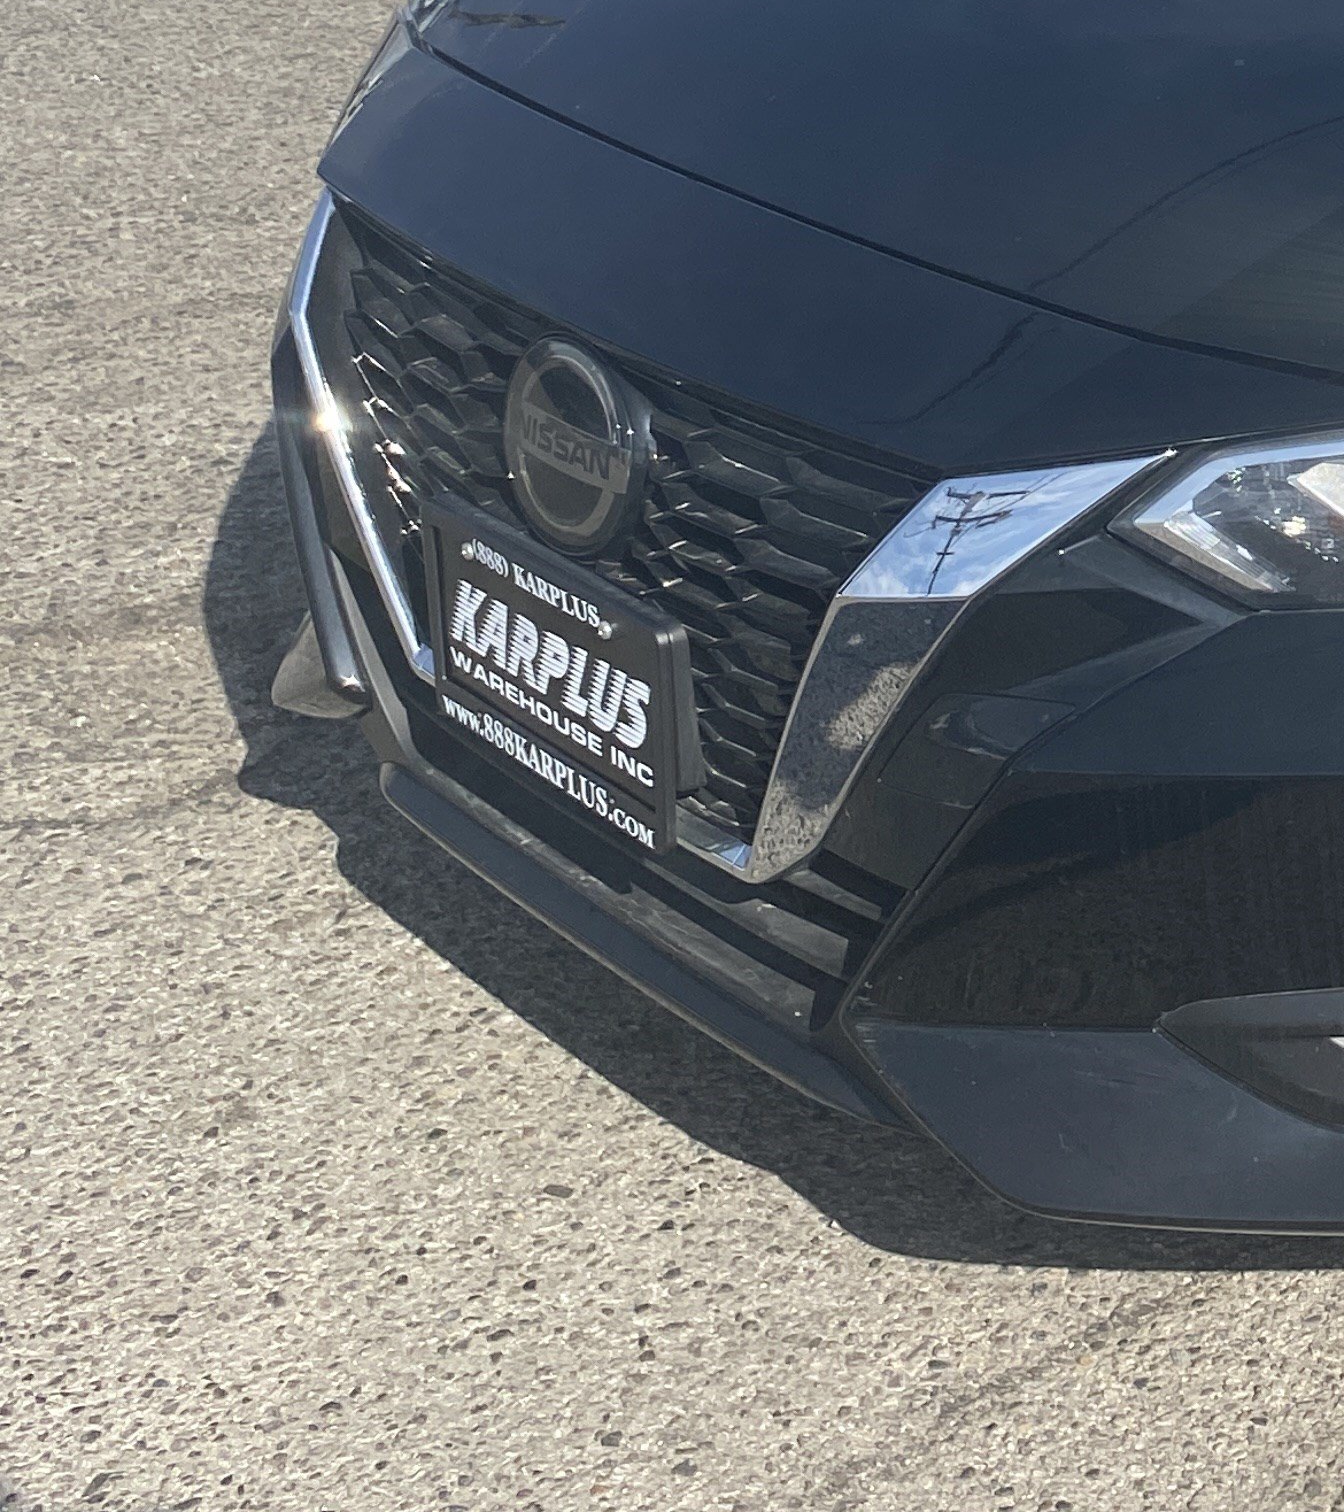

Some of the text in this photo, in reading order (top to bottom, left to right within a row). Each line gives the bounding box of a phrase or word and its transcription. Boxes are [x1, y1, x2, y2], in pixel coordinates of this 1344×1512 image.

[521, 413, 614, 481] NISSAN
[510, 561, 601, 629] KARPLUS
[449, 578, 651, 749] KARPLUS
[449, 645, 654, 788] WAREHOUSE INC
